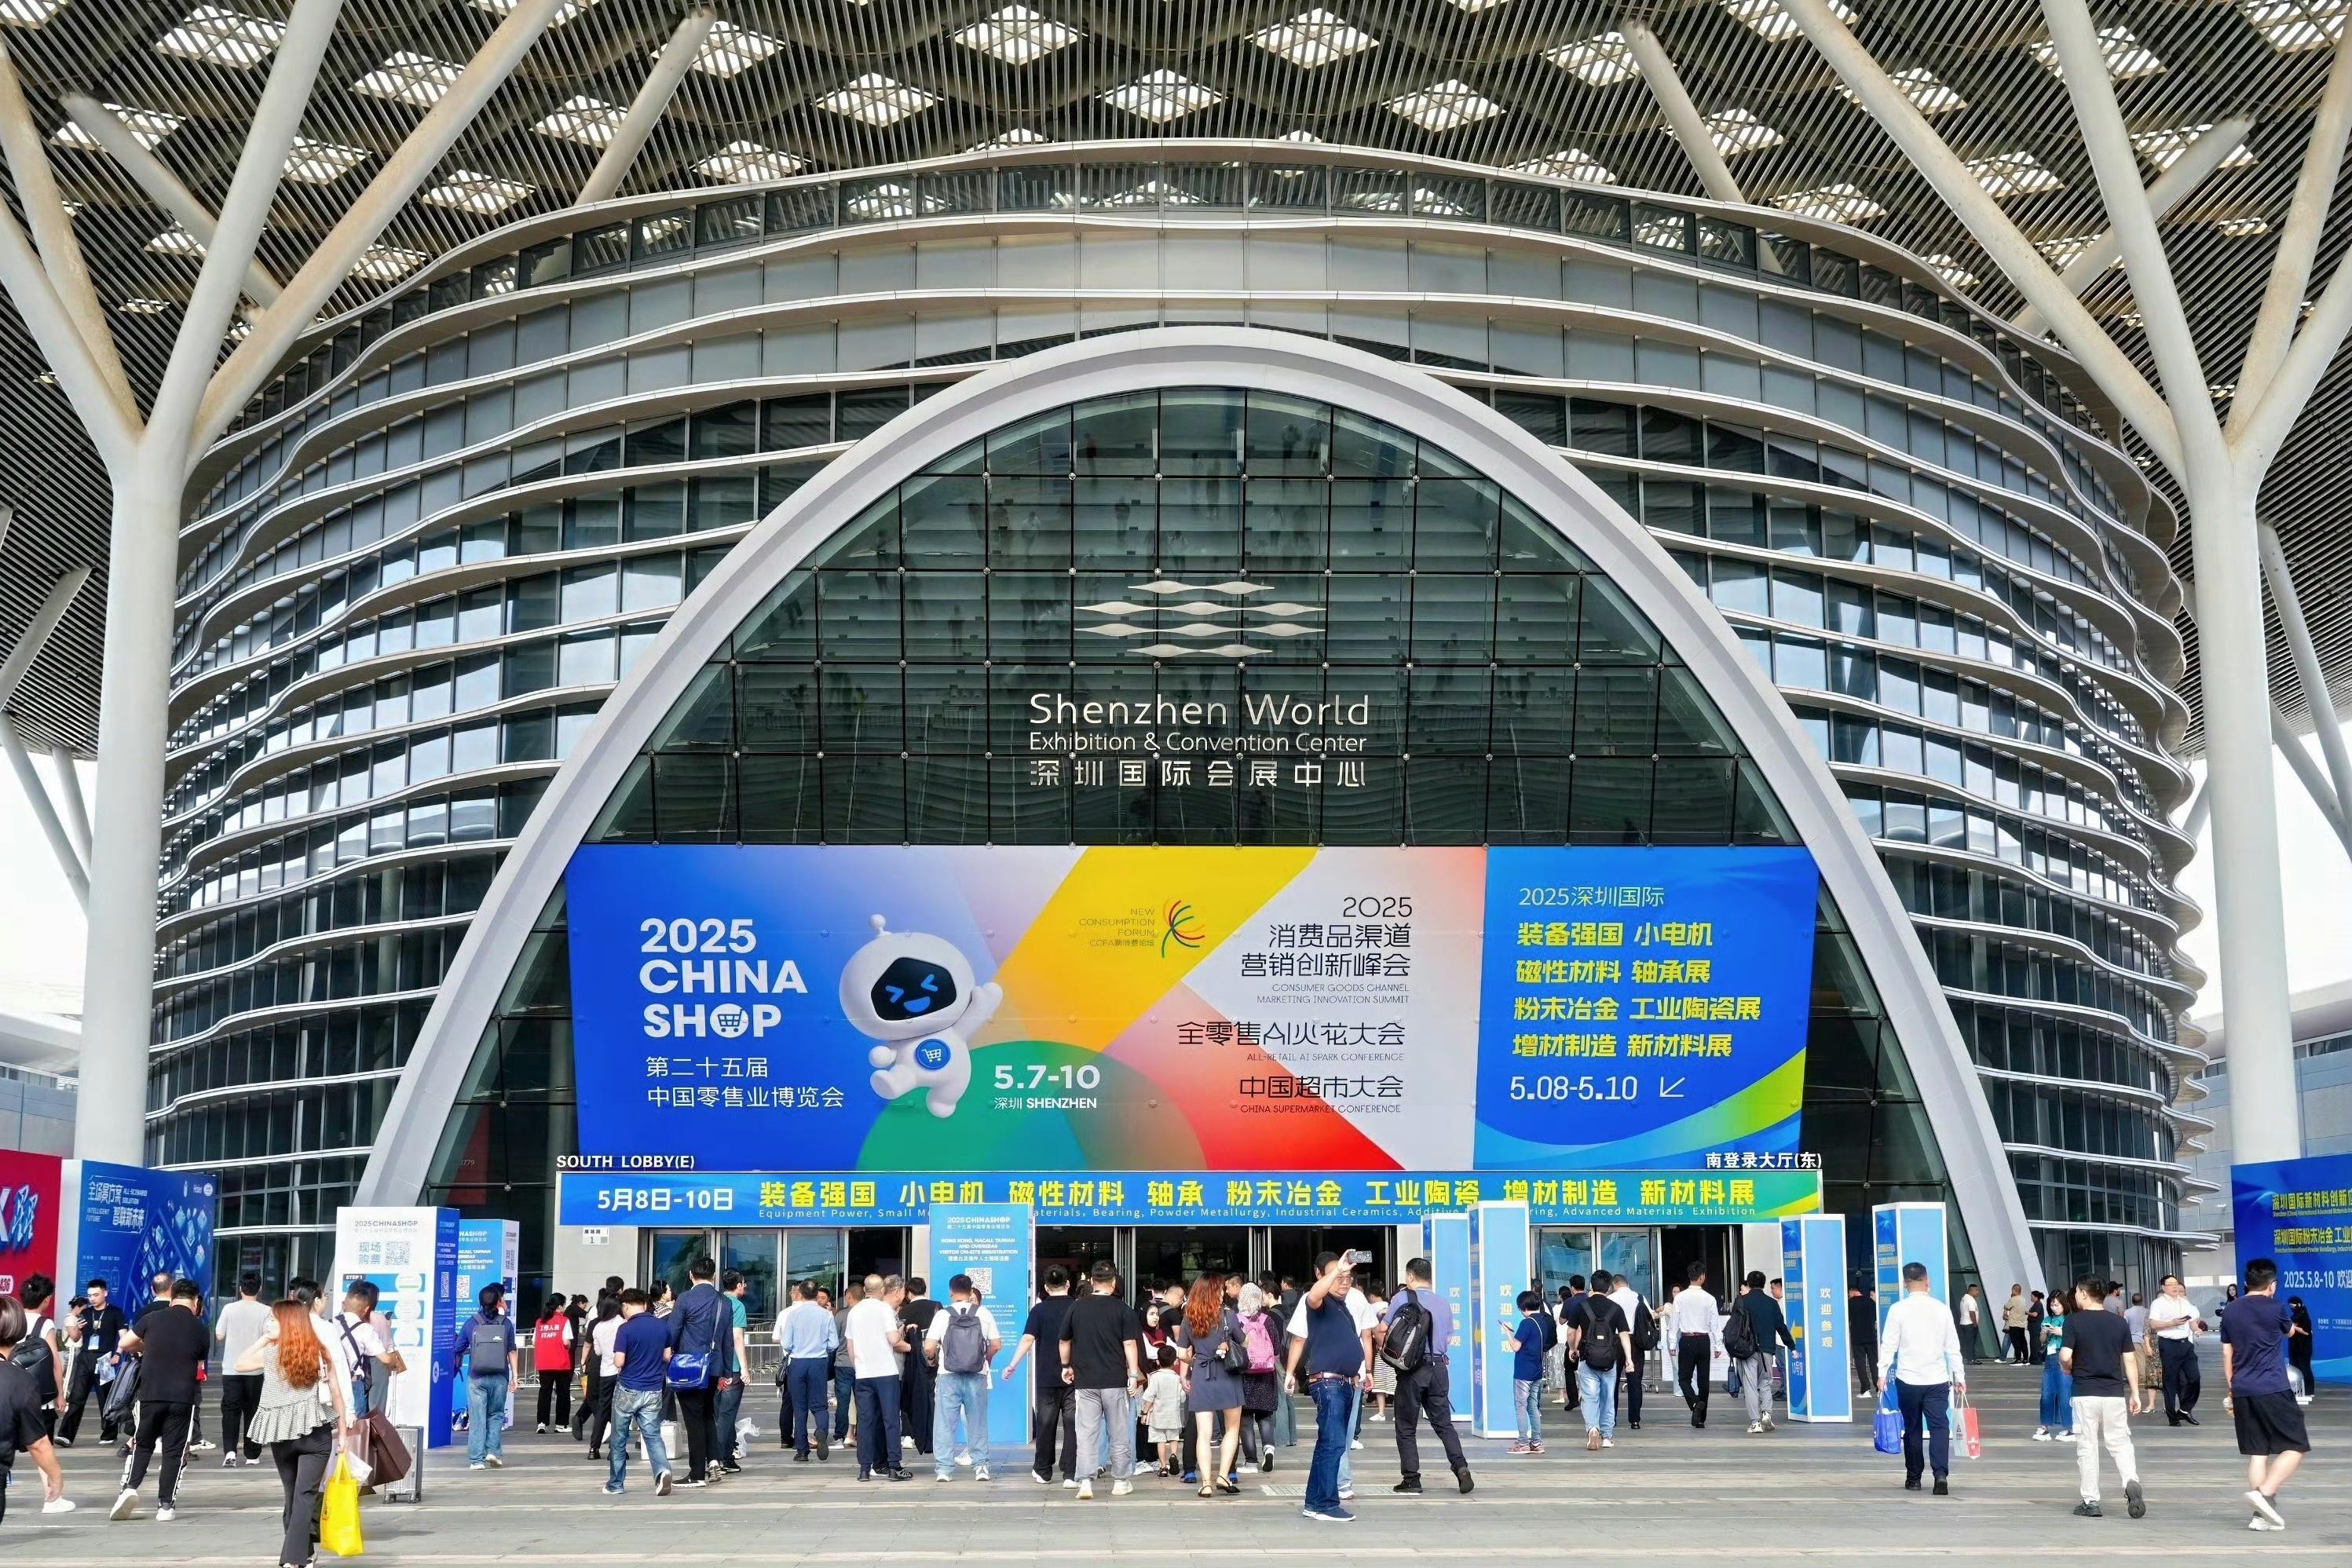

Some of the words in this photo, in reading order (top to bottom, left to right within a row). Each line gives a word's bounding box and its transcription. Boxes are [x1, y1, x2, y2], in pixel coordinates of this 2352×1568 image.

[1030, 693, 1226, 725] Shenzhen
[1245, 694, 1369, 726] World
[1030, 733, 1136, 751] Exhibition
[1144, 733, 1160, 751] &
[1166, 733, 1289, 752] Convention
[1296, 733, 1367, 752] Center
[1030, 760, 1365, 787] 深圳国际会展中心
[1343, 897, 1412, 918] 2025
[1519, 886, 1665, 908] 2025深圳国际
[640, 918, 757, 953] 2025
[1269, 923, 1411, 948] 消费品渠道
[1518, 922, 1623, 946] 装备强国
[1633, 922, 1713, 946] 小电机
[639, 959, 807, 994] CHINA
[1242, 952, 1410, 978] 营销创新峰会
[1516, 959, 1621, 984] 磁性材料
[1631, 959, 1710, 984] 轴承展
[1514, 996, 1619, 1021] 粉末冶金
[1630, 996, 1761, 1021] 工业陶瓷展
[643, 1003, 781, 1039] SHOP
[1176, 1022, 1405, 1046] 全零售AI火花大会
[1512, 1034, 1617, 1058] 增材制造
[1627, 1033, 1732, 1058] 新材料展
[646, 1056, 769, 1079] 第二十五届
[993, 1065, 1100, 1090] 5.7-10
[647, 1087, 844, 1109] 中国零售业博览会
[1240, 1076, 1403, 1098] 中国超市大会
[1510, 1076, 1637, 1100] 5.08-5.10
[993, 1097, 1022, 1109] 深圳
[1026, 1098, 1097, 1109] SHENZHEN
[557, 1156, 613, 1168] SOUTH
[621, 1155, 695, 1168] LOBBY(E)
[1706, 1152, 1823, 1168] 南登录大厅(东)
[598, 1188, 733, 1211] 5月8日-10日
[759, 1181, 875, 1208] 装备强国
[899, 1181, 983, 1207] 小电机
[1009, 1180, 1124, 1207] 磁性材料
[1147, 1180, 1203, 1207] 轴承
[1227, 1180, 1342, 1206] 粉末冶金
[1366, 1180, 1480, 1206] 工业陶瓷
[1503, 1180, 1617, 1206] 增材制造
[1641, 1179, 1755, 1206] 新材料展
[759, 1209, 825, 1219] Equipment
[832, 1209, 872, 1219] Power,
[878, 1208, 912, 1217] Small
[1033, 1208, 1085, 1217] aterials,
[1093, 1208, 1144, 1218] Bearing,
[1150, 1208, 1195, 1216] Powder
[1201, 1208, 1270, 1218] Metallurgy,
[1276, 1208, 1337, 1216] Industrial
[1342, 1208, 1402, 1217] Ceramics,
[1563, 1207, 1621, 1215] Advanced
[1626, 1207, 1683, 1215] Materials
[1692, 1207, 1755, 1215] Exhibition
[359, 1241, 382, 1252] 现场
[2274, 1226, 2333, 1245] 深圳国际粉末冶金
[2335, 1226, 2352, 1243] 工业
[358, 1254, 381, 1265] 购票
[2284, 1270, 2334, 1288] 2025.5.8-10
[1820, 1288, 1833, 1348] 欢迎参观
